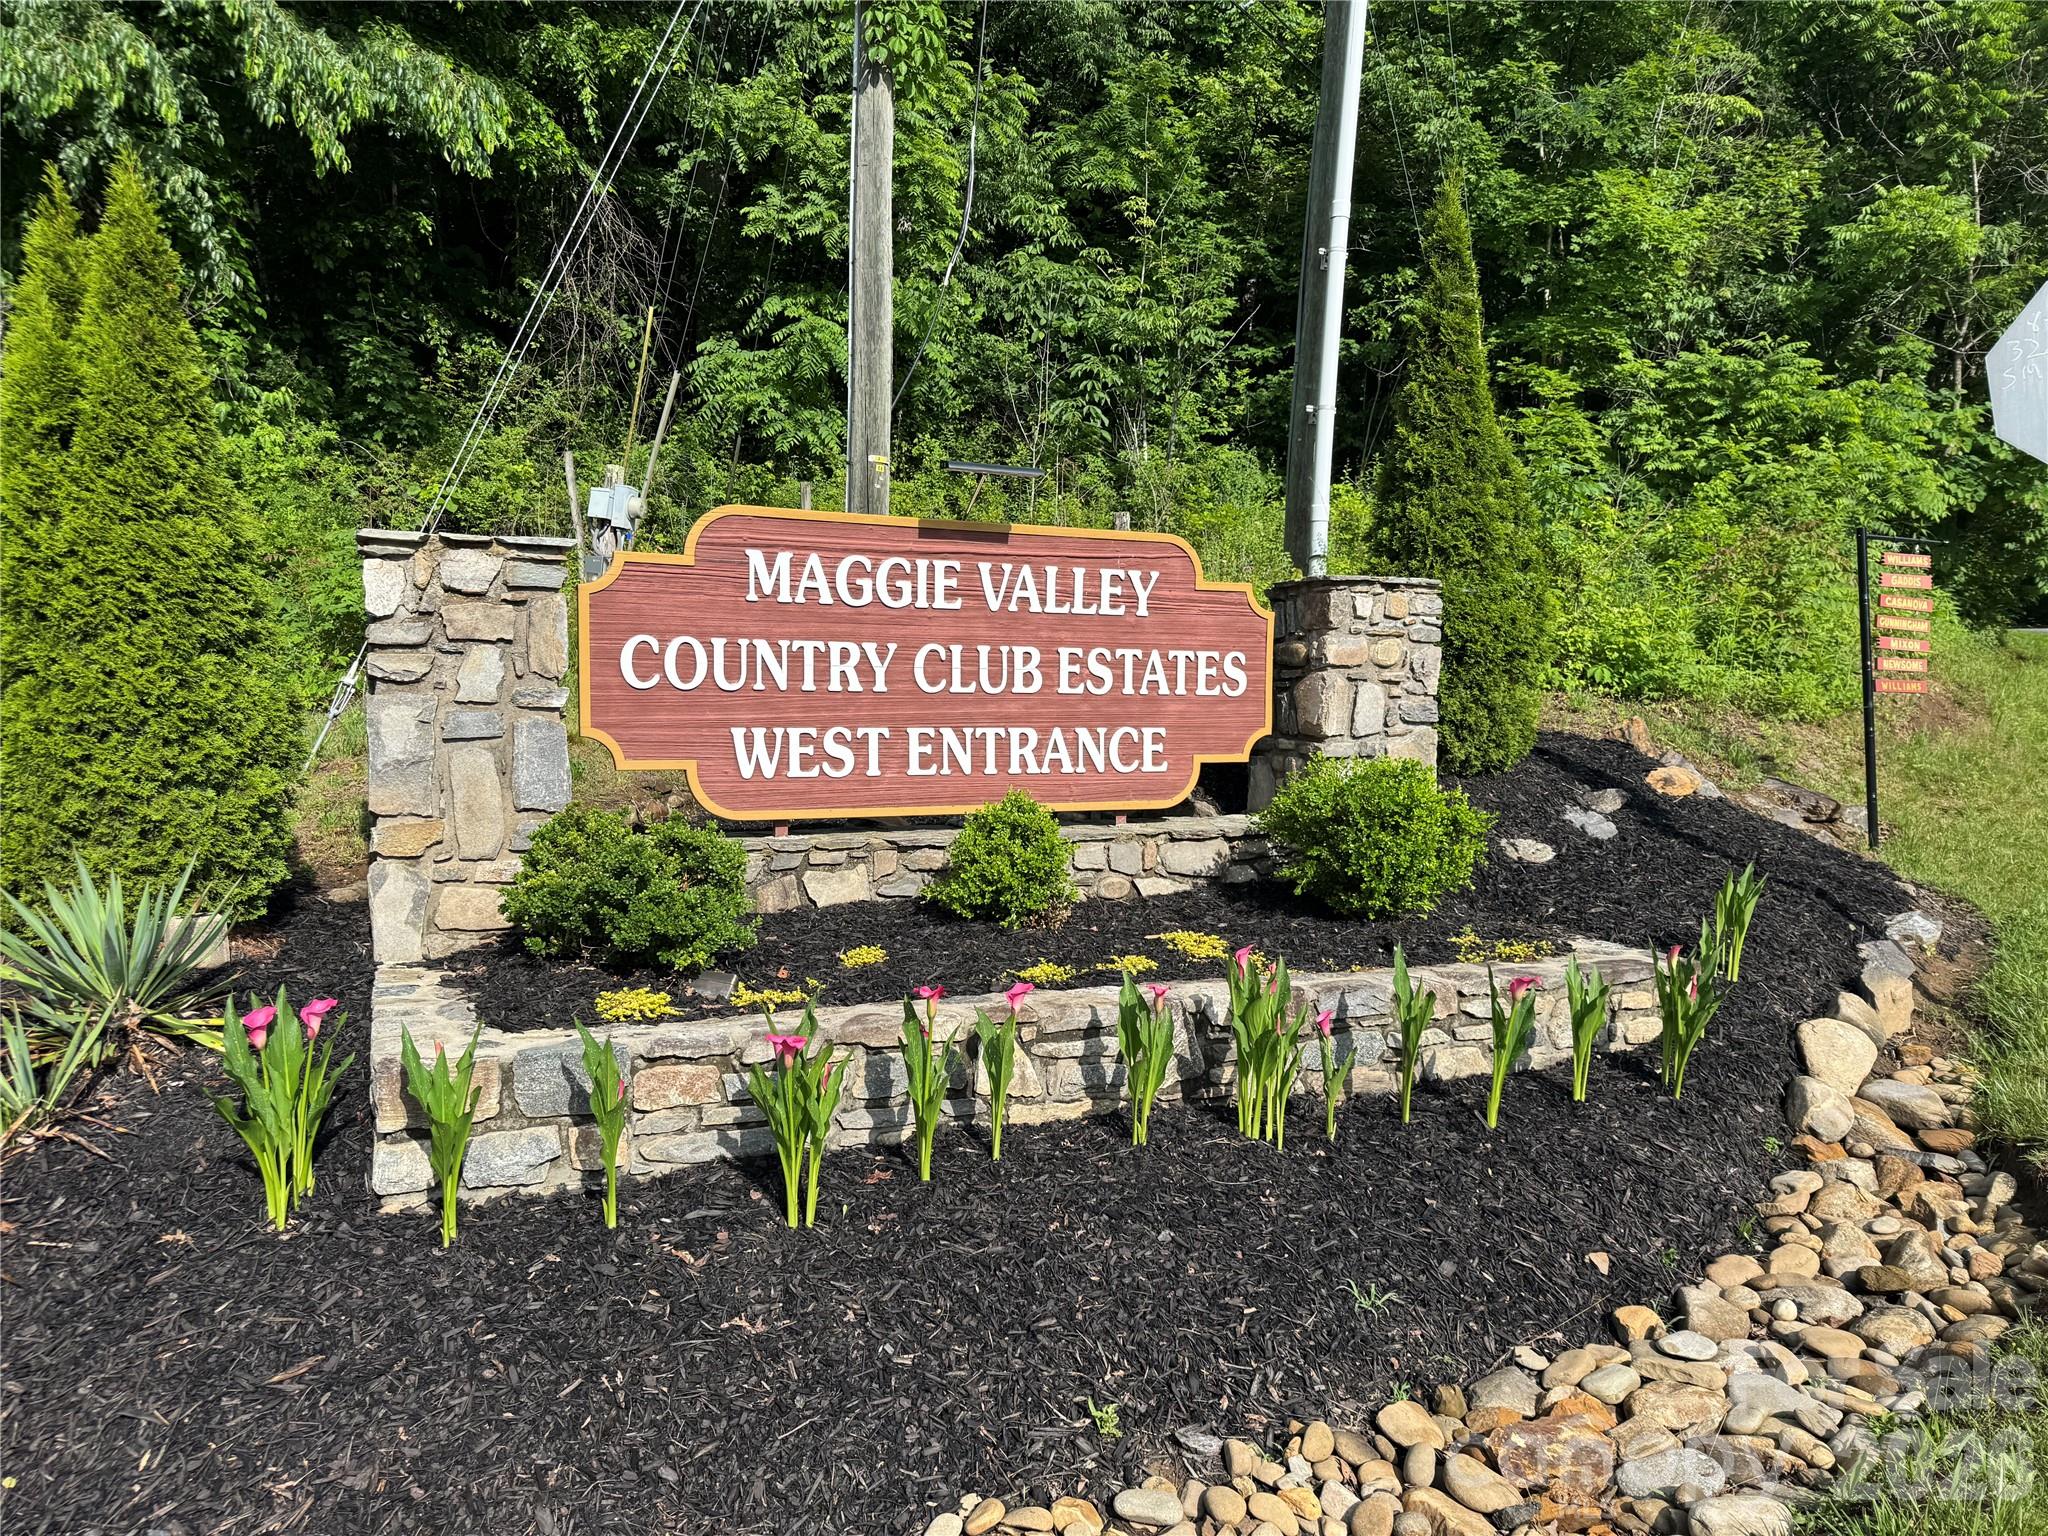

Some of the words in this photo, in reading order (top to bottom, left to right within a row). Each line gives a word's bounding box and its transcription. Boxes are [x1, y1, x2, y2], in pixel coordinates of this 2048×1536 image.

[1887, 554, 1928, 566] WILLIAMS
[745, 549, 961, 609] MAGGIE
[977, 562, 1159, 616] VALLEY
[1891, 575, 1921, 587] GADDIS
[1885, 596, 1928, 610] CASANOVA
[1890, 637, 1921, 649] MIXON
[619, 634, 897, 692] COUNTRY
[913, 643, 1043, 694] CLUB
[1056, 647, 1248, 697] ESTATES
[1881, 681, 1922, 693] WILLIAMS
[730, 726, 890, 779] WEST
[906, 726, 1169, 776] ENTRANCE
